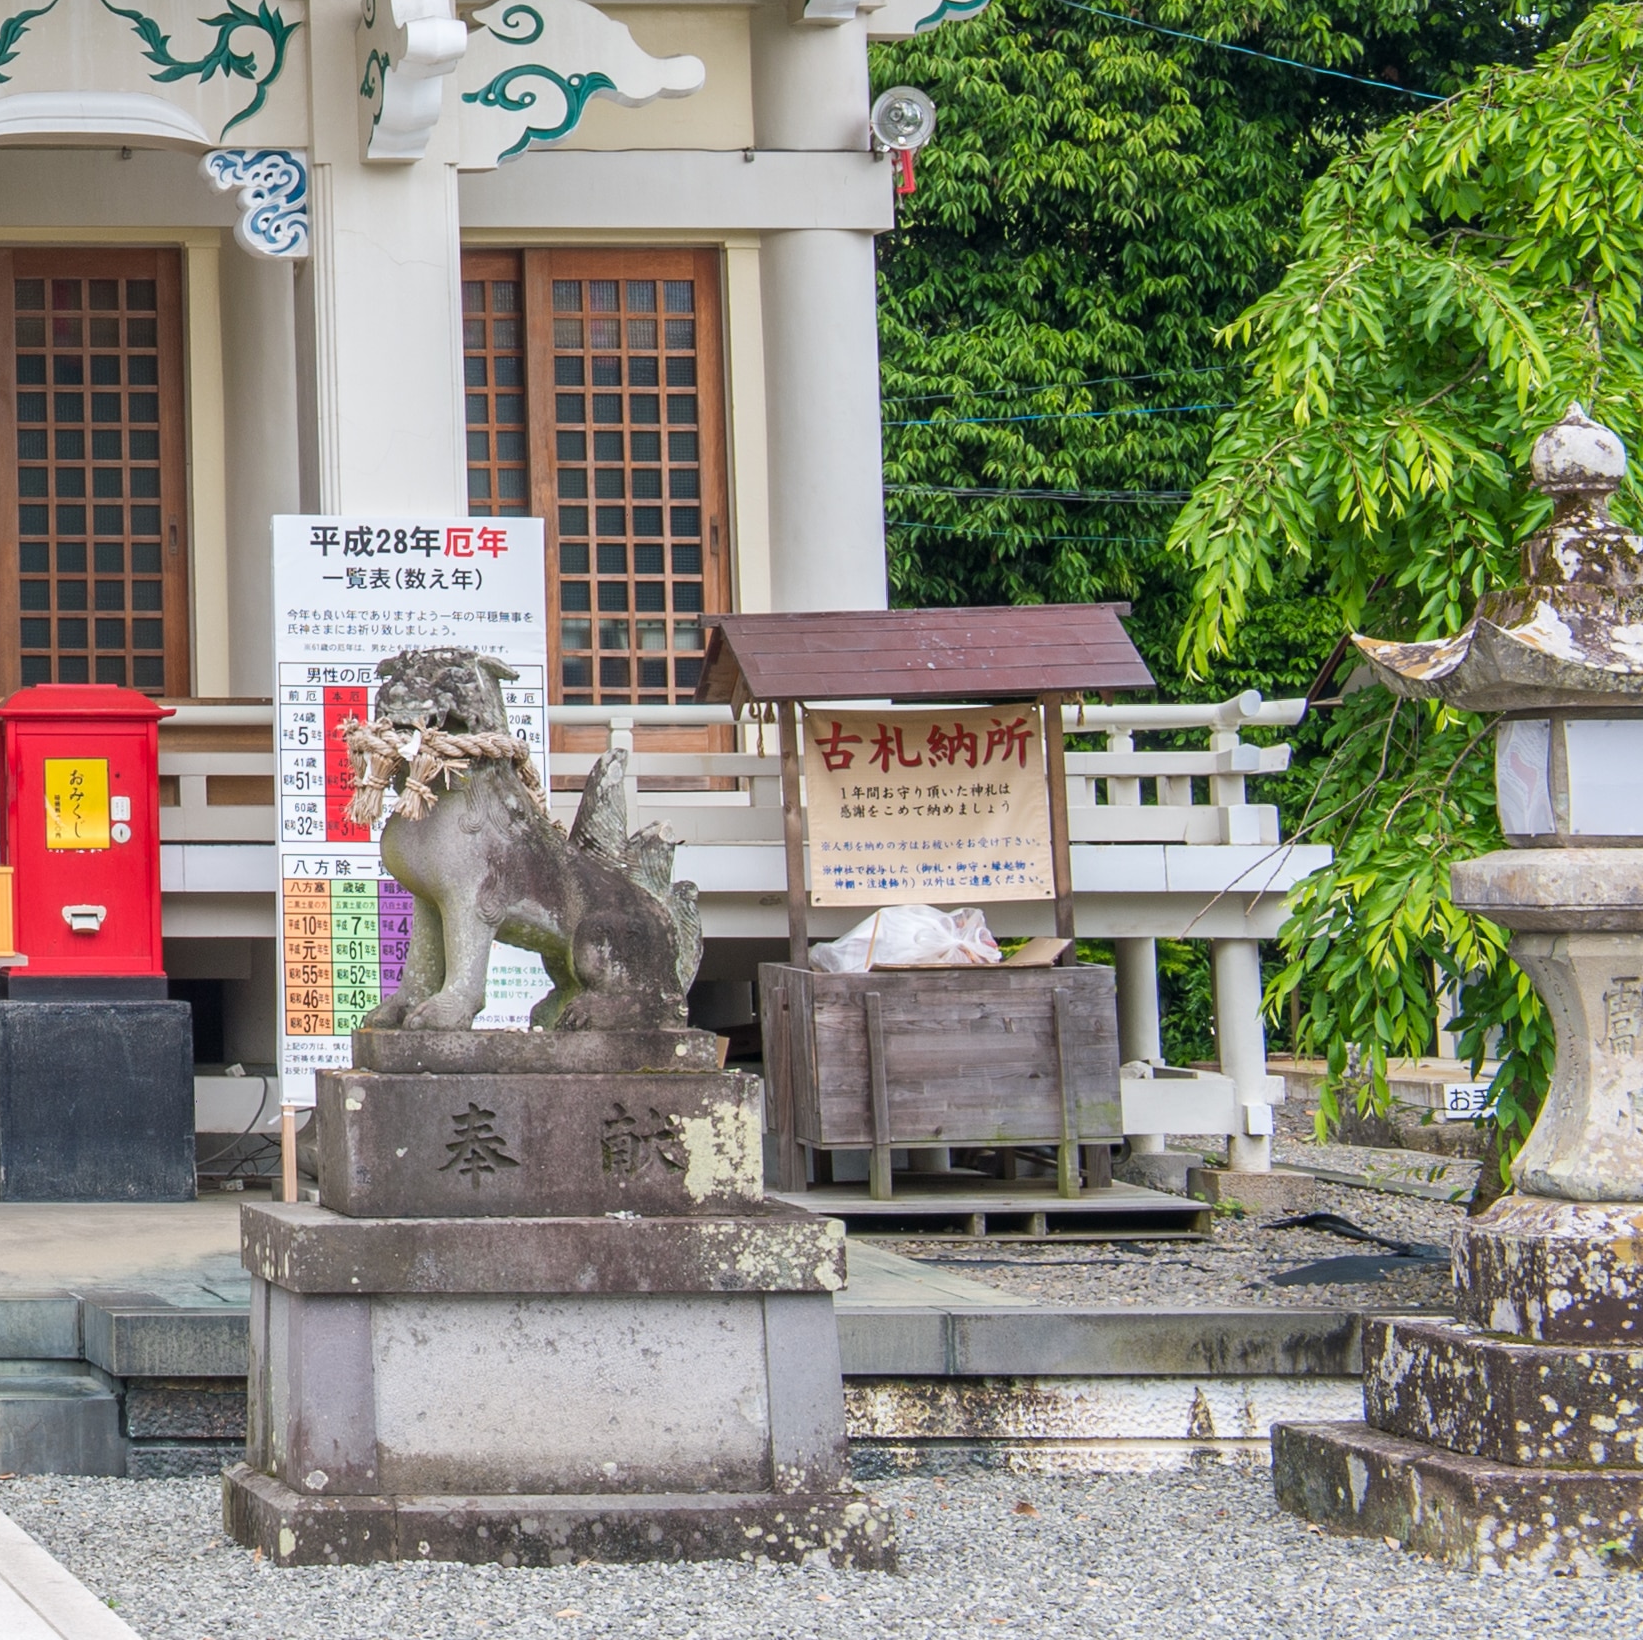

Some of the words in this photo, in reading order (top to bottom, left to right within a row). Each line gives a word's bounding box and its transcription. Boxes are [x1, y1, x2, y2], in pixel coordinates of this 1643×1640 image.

[309, 525, 509, 558] 平成28年厄年
[293, 712, 317, 723] 24歳
[815, 717, 1035, 773] 古札納所
[293, 757, 317, 768] 41歳
[69, 769, 85, 839] おみくじ
[294, 803, 318, 813] 60歳
[840, 801, 1011, 818] 感謝をこめて納めましょう
[436, 1102, 521, 1192] 奉
